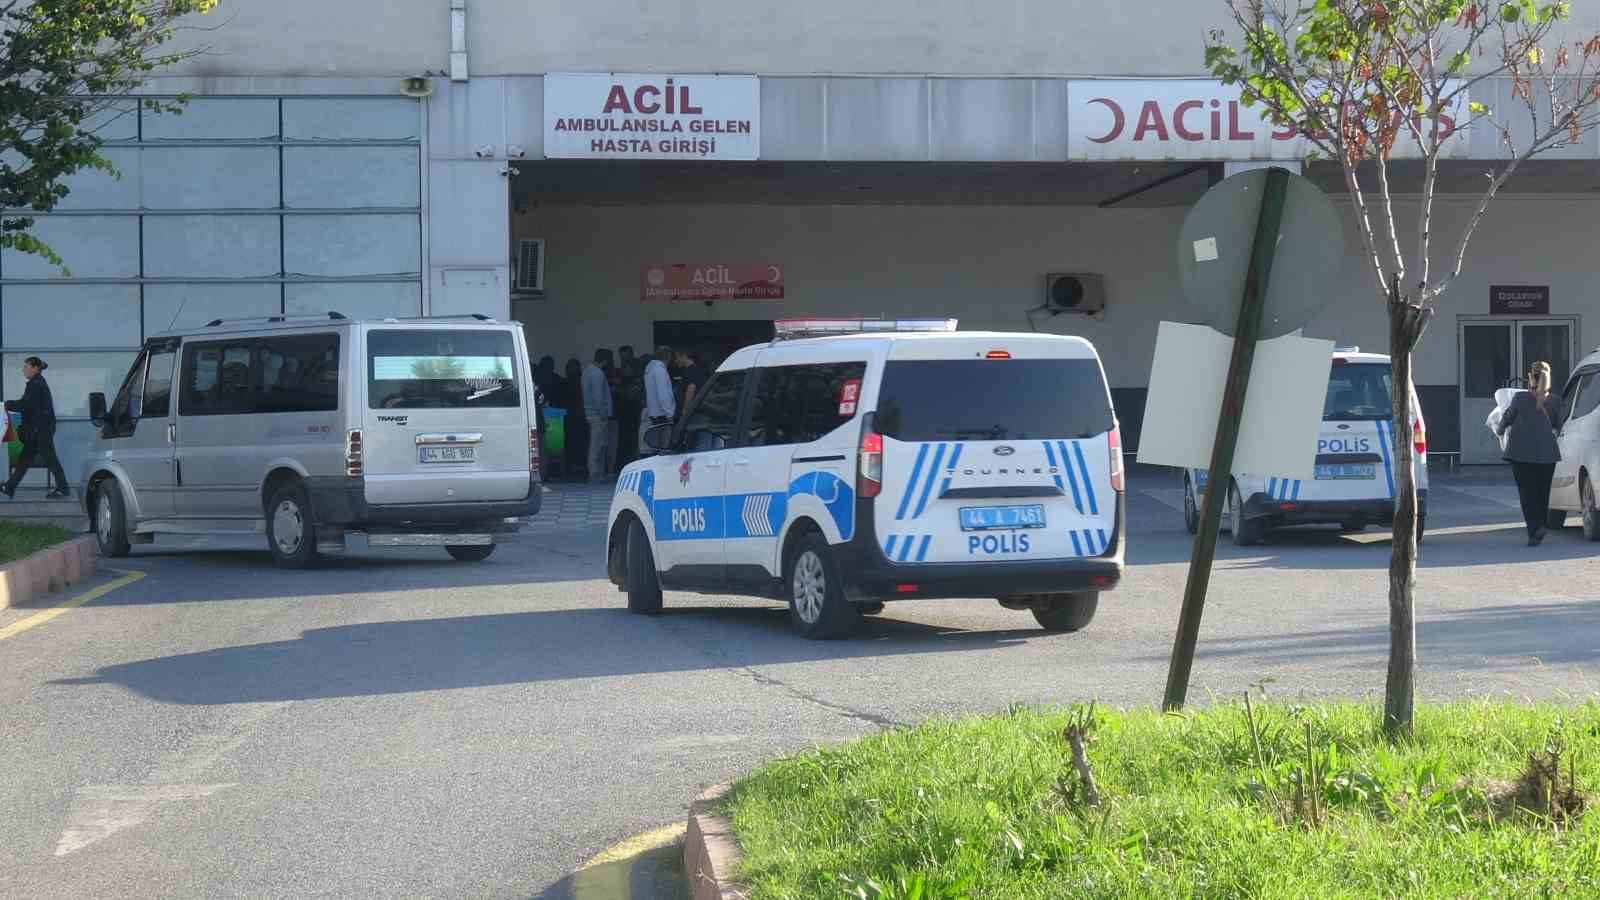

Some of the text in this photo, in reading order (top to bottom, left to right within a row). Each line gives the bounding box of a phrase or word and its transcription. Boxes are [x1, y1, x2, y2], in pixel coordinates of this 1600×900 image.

[602, 78, 703, 115] ACİL
[554, 118, 751, 133] AMBULANSLA GELEN
[591, 136, 716, 156] HASTA GİRİŞİ
[671, 499, 706, 532] POLİS
[995, 510, 1006, 523] A
[968, 529, 1030, 554] POLİS
